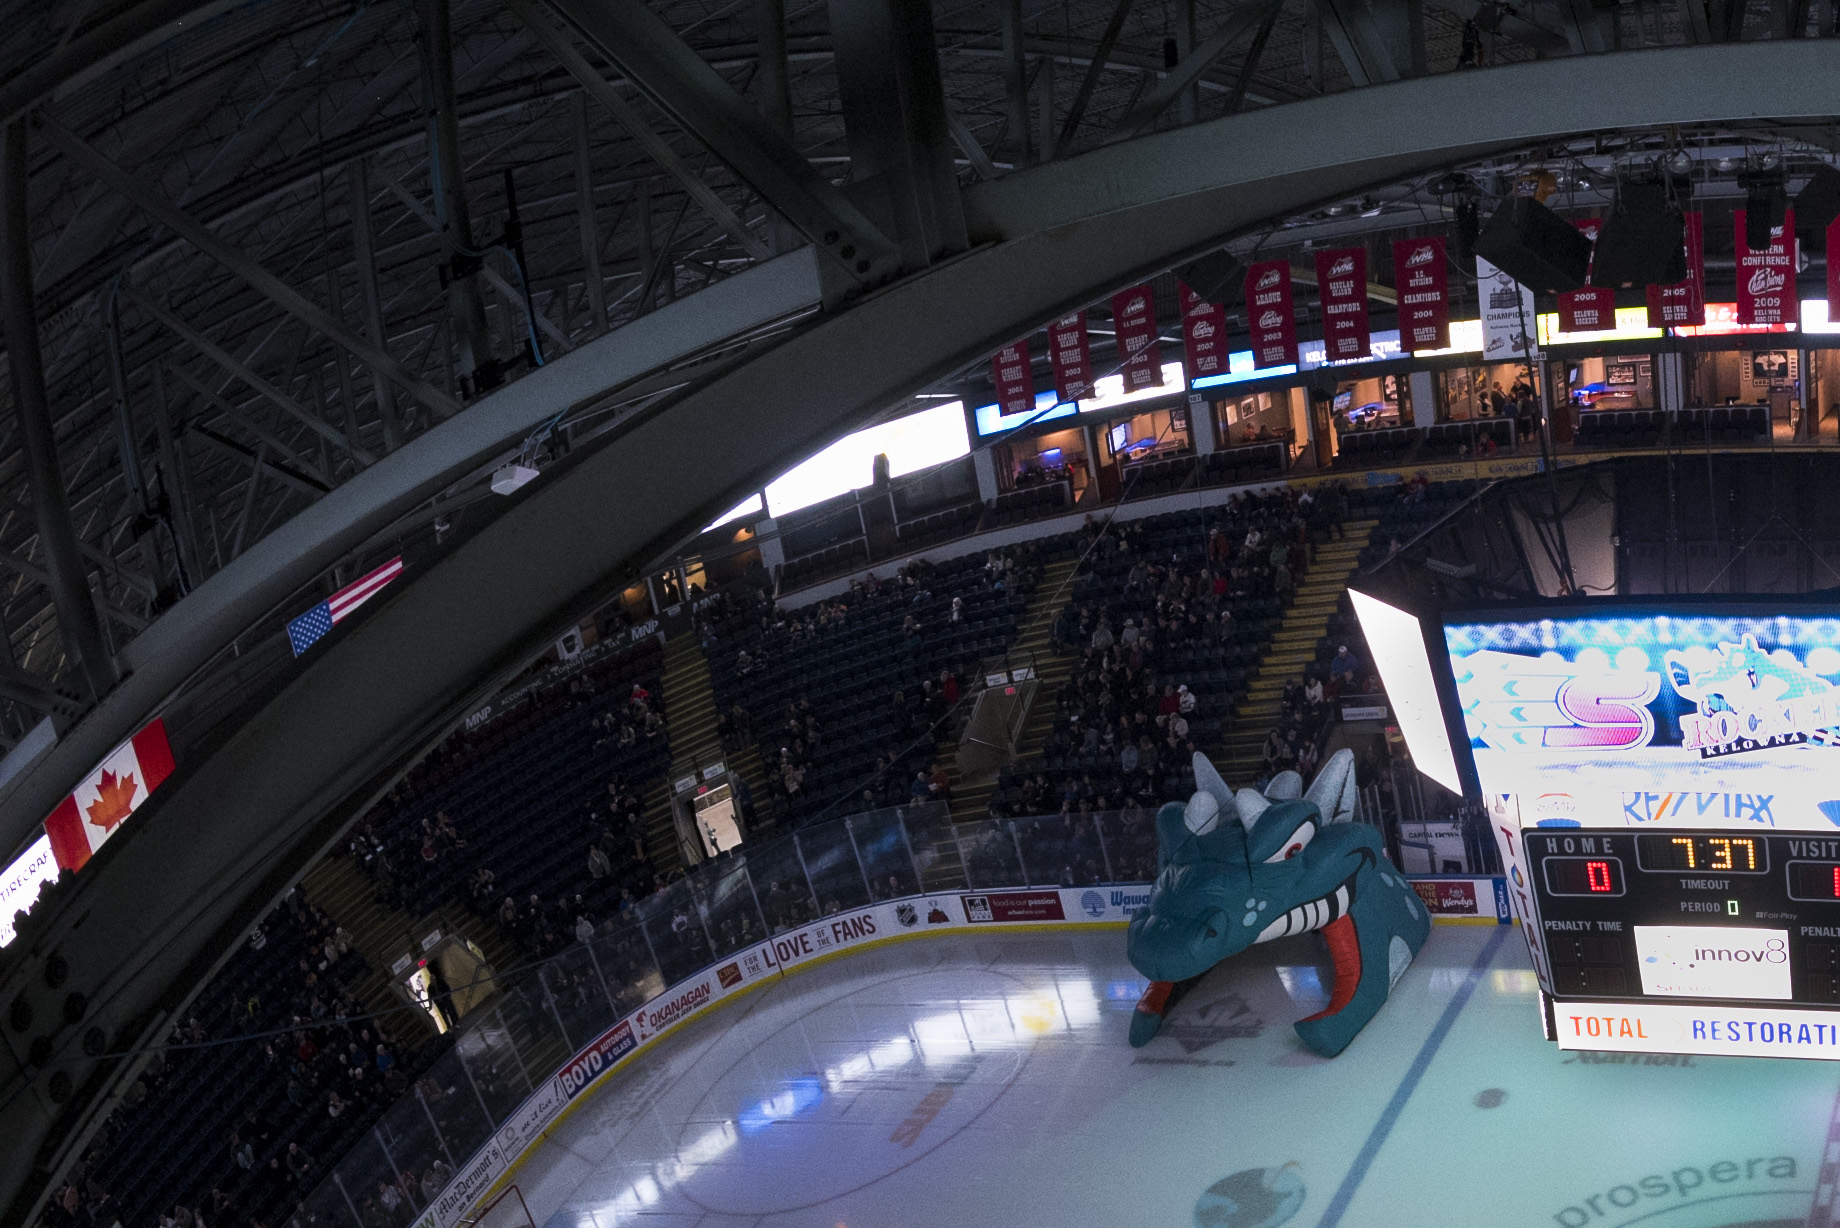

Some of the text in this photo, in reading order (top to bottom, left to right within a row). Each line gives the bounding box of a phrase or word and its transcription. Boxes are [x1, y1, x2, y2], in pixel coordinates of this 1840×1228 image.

[1256, 292, 1281, 305] LEAGUE
[1404, 292, 1441, 304] CHAMPIONS
[1574, 293, 1596, 301] 2005
[1327, 302, 1361, 314] CHAMPIONS
[1413, 310, 1433, 319] 2004
[1574, 310, 1599, 318] KELOWNA
[1575, 317, 1599, 325] ROCKETS
[1263, 332, 1282, 341] 2003
[465, 619, 659, 729] MNP ACCOUNTING MNP
[1706, 732, 1801, 757] KELOWNA
[1622, 792, 1776, 827] RE/MAX
[1546, 837, 1614, 854] HOME
[1671, 838, 1757, 870] 7:37
[1586, 862, 1611, 892] 0
[1679, 878, 1730, 890] TIMEOUT
[1027, 898, 1057, 908] passion
[1441, 896, 1474, 908] Wendy's
[1680, 901, 1721, 914] PERIOD
[1763, 911, 1799, 922] Fair-Play
[831, 914, 877, 944] FANS
[1544, 920, 1623, 933] PENALTY TIME
[816, 929, 831, 947] OF THE
[762, 932, 814, 969] LOVE
[1694, 937, 1788, 965] innov8
[746, 963, 761, 976] THE
[649, 981, 711, 1028] OKANAGAN
[655, 996, 711, 1032] CHRYSLER JEEP DODGE
[1568, 1015, 1649, 1040] TOTAL
[600, 1024, 633, 1053] AUTOBODY
[612, 1038, 632, 1057] GLASS
[561, 1049, 604, 1095] BOYD
[441, 1146, 499, 1220] MacDermott's
[457, 1173, 490, 1212] on Bernard
